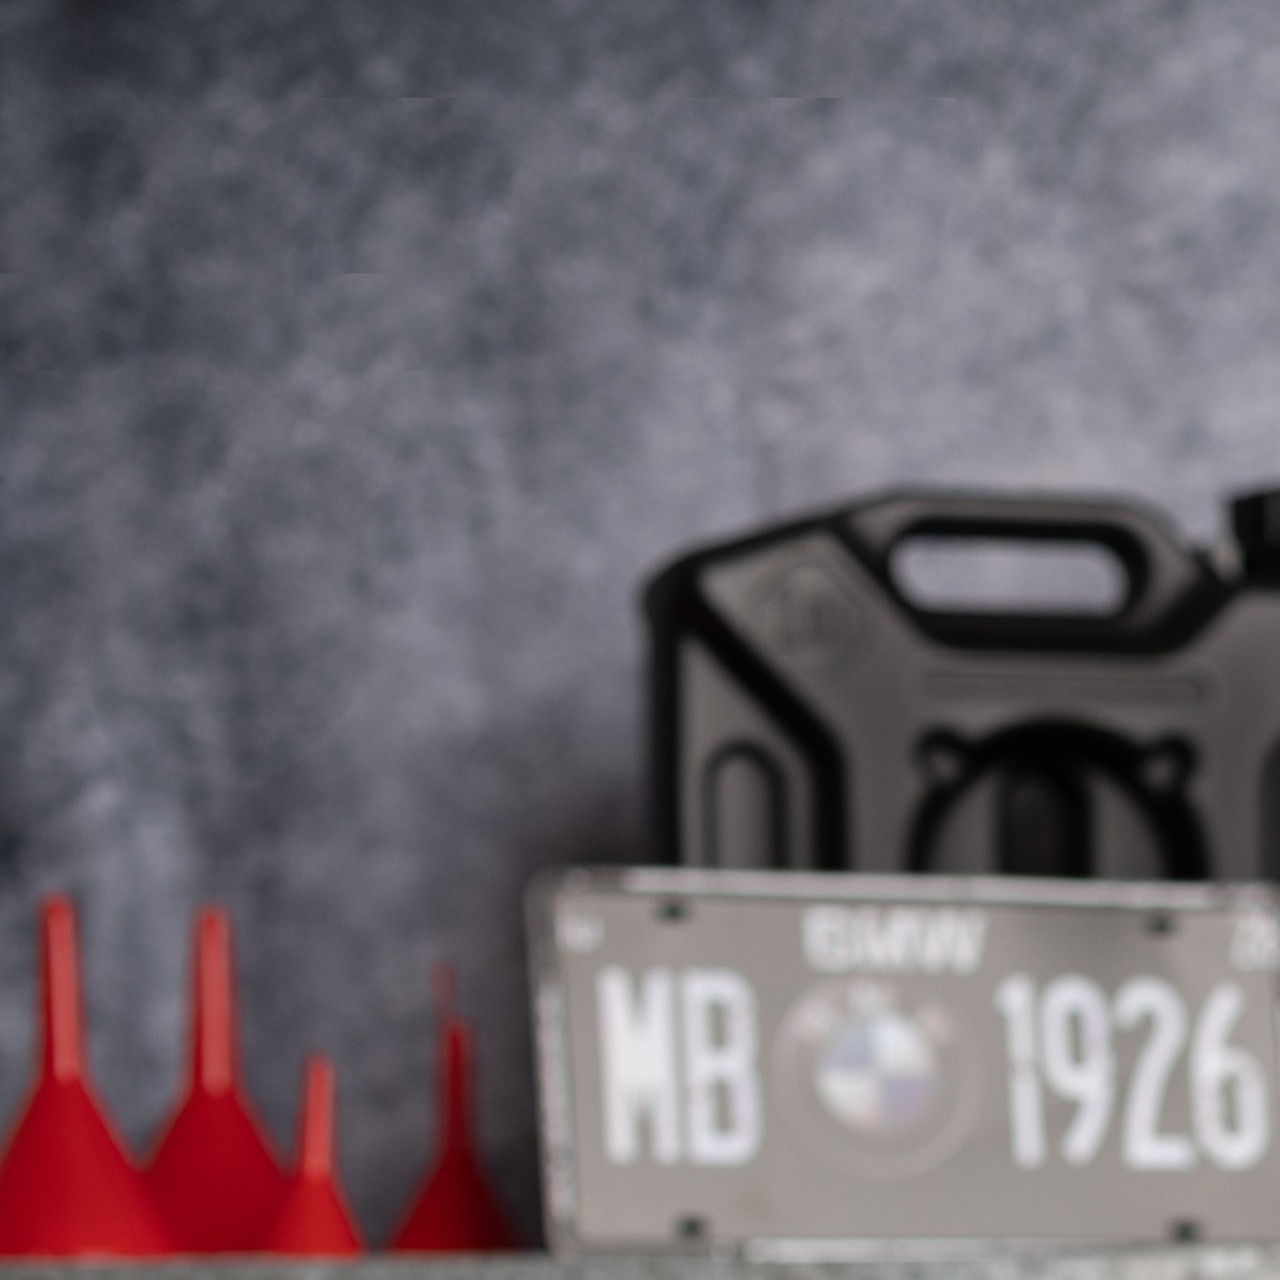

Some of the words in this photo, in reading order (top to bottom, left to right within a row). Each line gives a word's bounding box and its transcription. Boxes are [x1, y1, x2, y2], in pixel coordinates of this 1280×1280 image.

[803, 904, 988, 974] BMW
[601, 966, 763, 1168] MB
[996, 973, 1270, 1170] 1926
